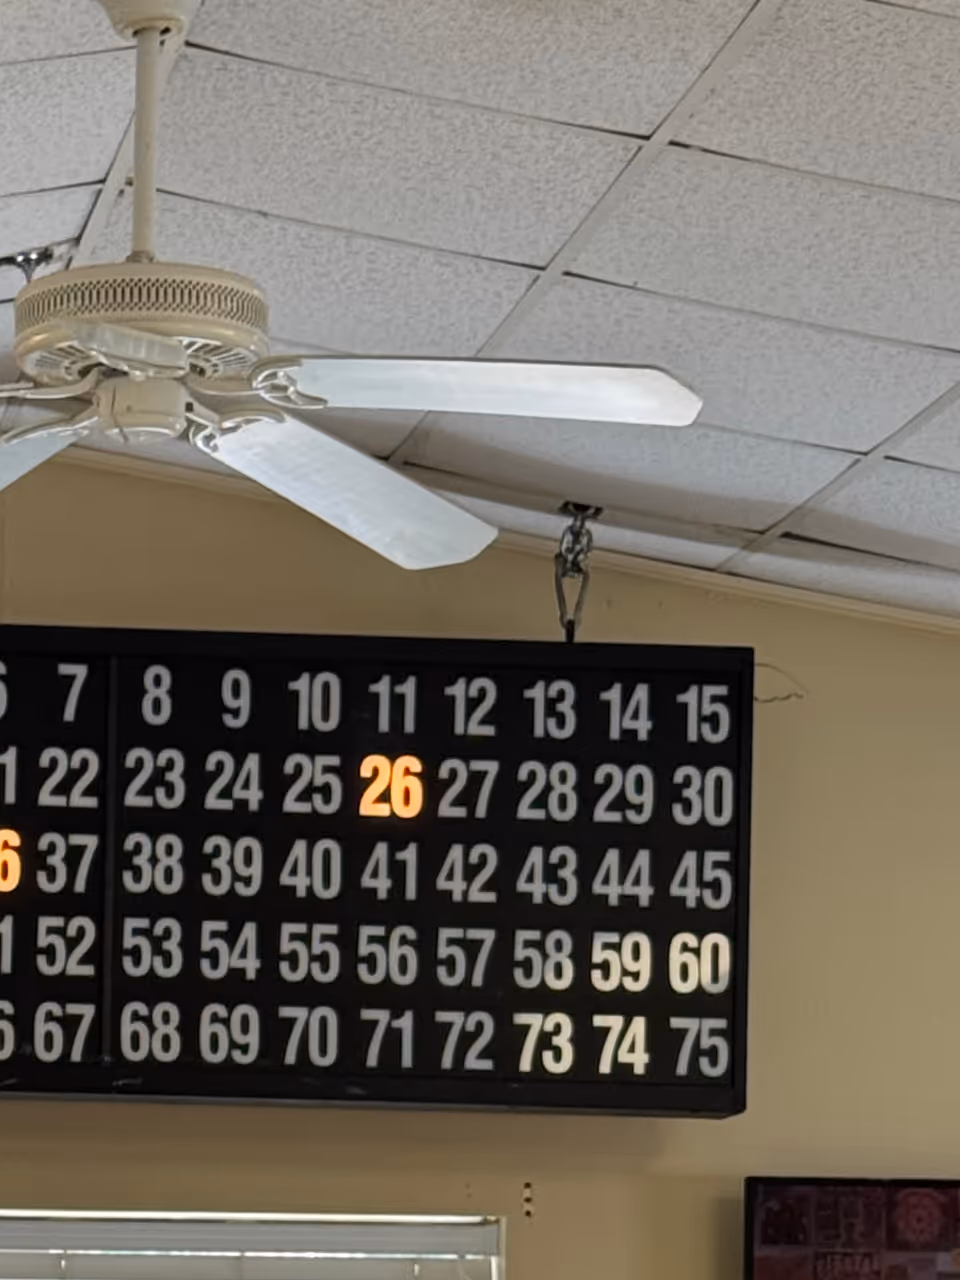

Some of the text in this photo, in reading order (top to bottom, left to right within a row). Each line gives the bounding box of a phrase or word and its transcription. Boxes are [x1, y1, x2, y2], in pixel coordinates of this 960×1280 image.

[59, 665, 86, 720] 7
[143, 666, 170, 724] 8
[223, 670, 249, 727] 9
[290, 673, 339, 730] 10
[370, 676, 415, 732] 11
[446, 678, 496, 735] 12
[525, 681, 575, 738] 13
[601, 684, 651, 740] 14
[678, 686, 729, 742] 15
[39, 748, 98, 807] 22
[125, 749, 184, 808] 23
[206, 751, 262, 810] 24
[284, 754, 341, 813] 25
[359, 754, 423, 818] 26
[439, 759, 498, 817] 27
[518, 761, 576, 820] 28
[594, 765, 653, 823] 29
[673, 766, 732, 825] 30
[37, 833, 97, 892] 37
[124, 833, 182, 893] 38
[203, 836, 262, 895] 39
[280, 840, 340, 898] 40
[362, 843, 416, 899] 41
[437, 845, 497, 902] 42
[517, 847, 577, 905] 43
[593, 849, 653, 906] 44
[670, 852, 731, 908] 45
[37, 917, 95, 975] 52
[123, 918, 182, 977] 53
[201, 921, 260, 979] 54
[280, 924, 339, 982] 55
[358, 926, 417, 984] 56
[438, 929, 495, 986] 57
[514, 930, 573, 990] 58
[591, 932, 651, 992] 59
[669, 932, 730, 993] 60
[35, 1002, 94, 1061] 67
[121, 1002, 180, 1061] 68
[200, 1004, 259, 1063] 69
[280, 1007, 337, 1065] 70
[361, 1010, 412, 1067] 71
[436, 1012, 493, 1069] 72
[514, 1013, 573, 1073] 73
[593, 1015, 649, 1074] 74
[670, 1017, 728, 1076] 75
